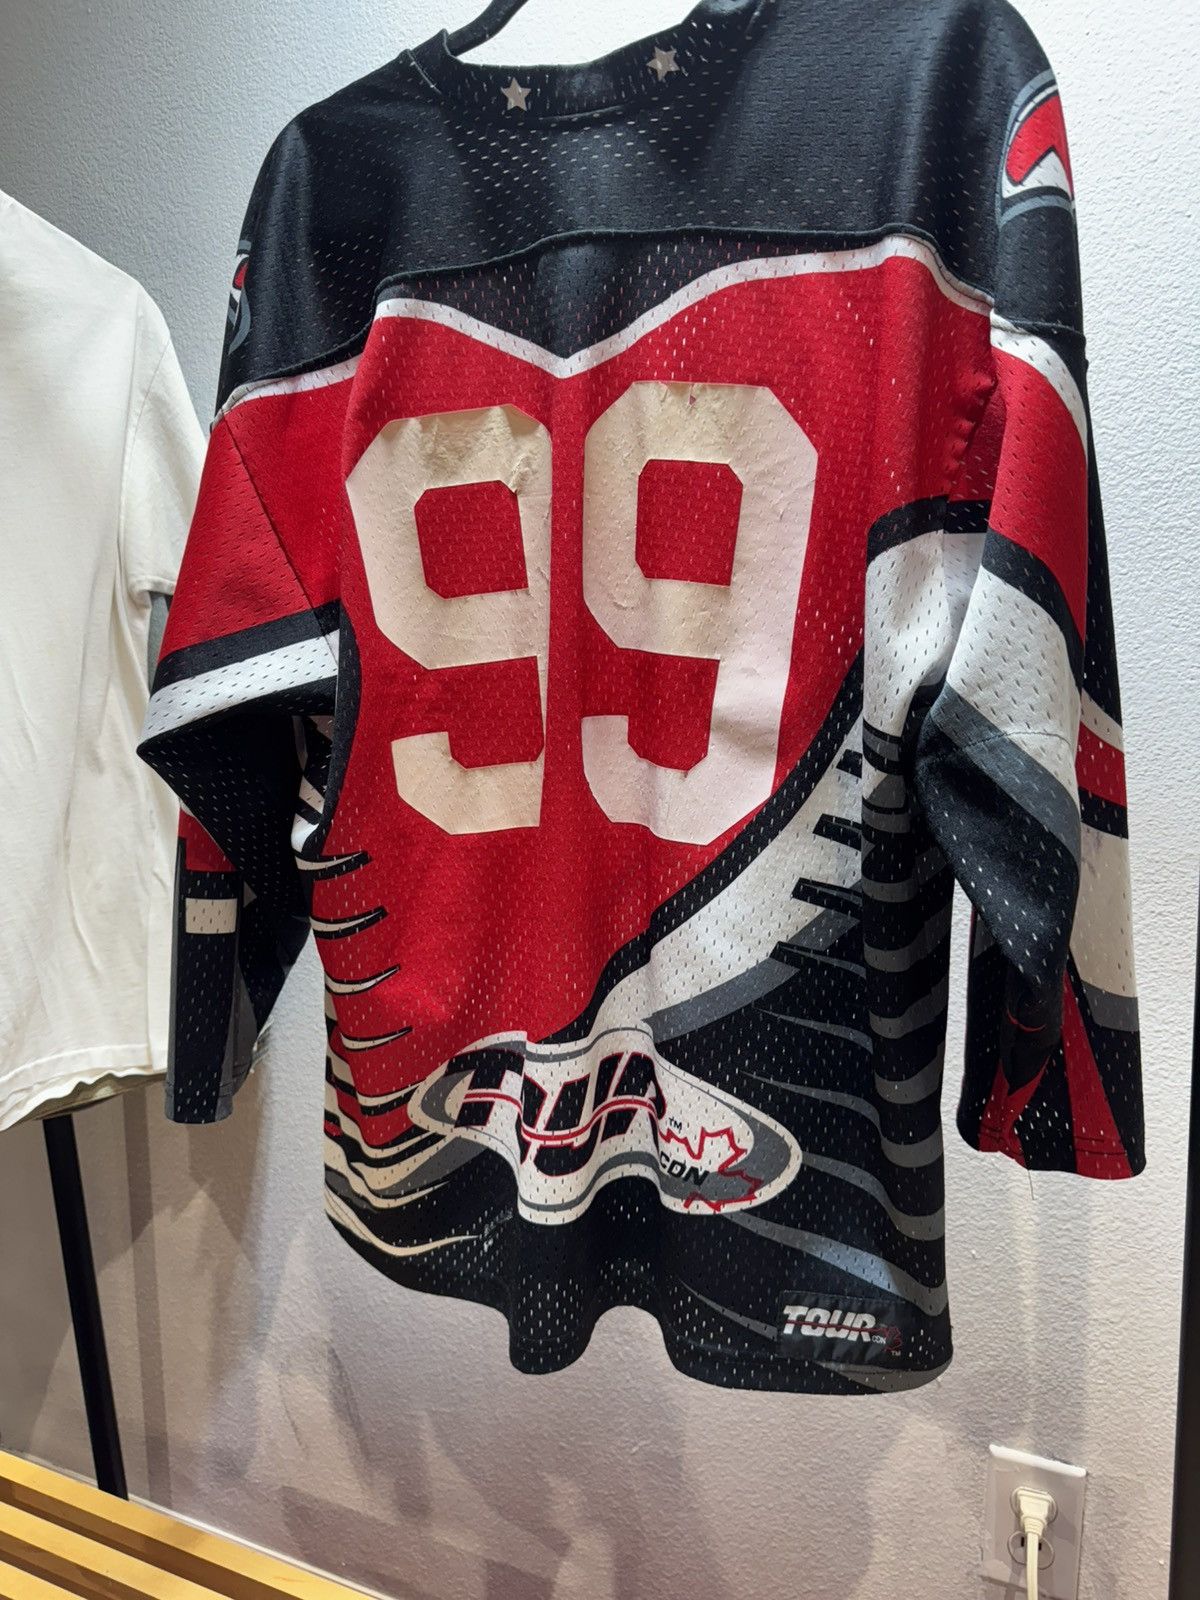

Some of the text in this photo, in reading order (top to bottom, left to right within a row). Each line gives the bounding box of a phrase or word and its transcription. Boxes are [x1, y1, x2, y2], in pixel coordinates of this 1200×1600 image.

[345, 380, 819, 846] 99
[660, 1150, 710, 1186] CDN
[783, 1305, 876, 1342] TOUR
